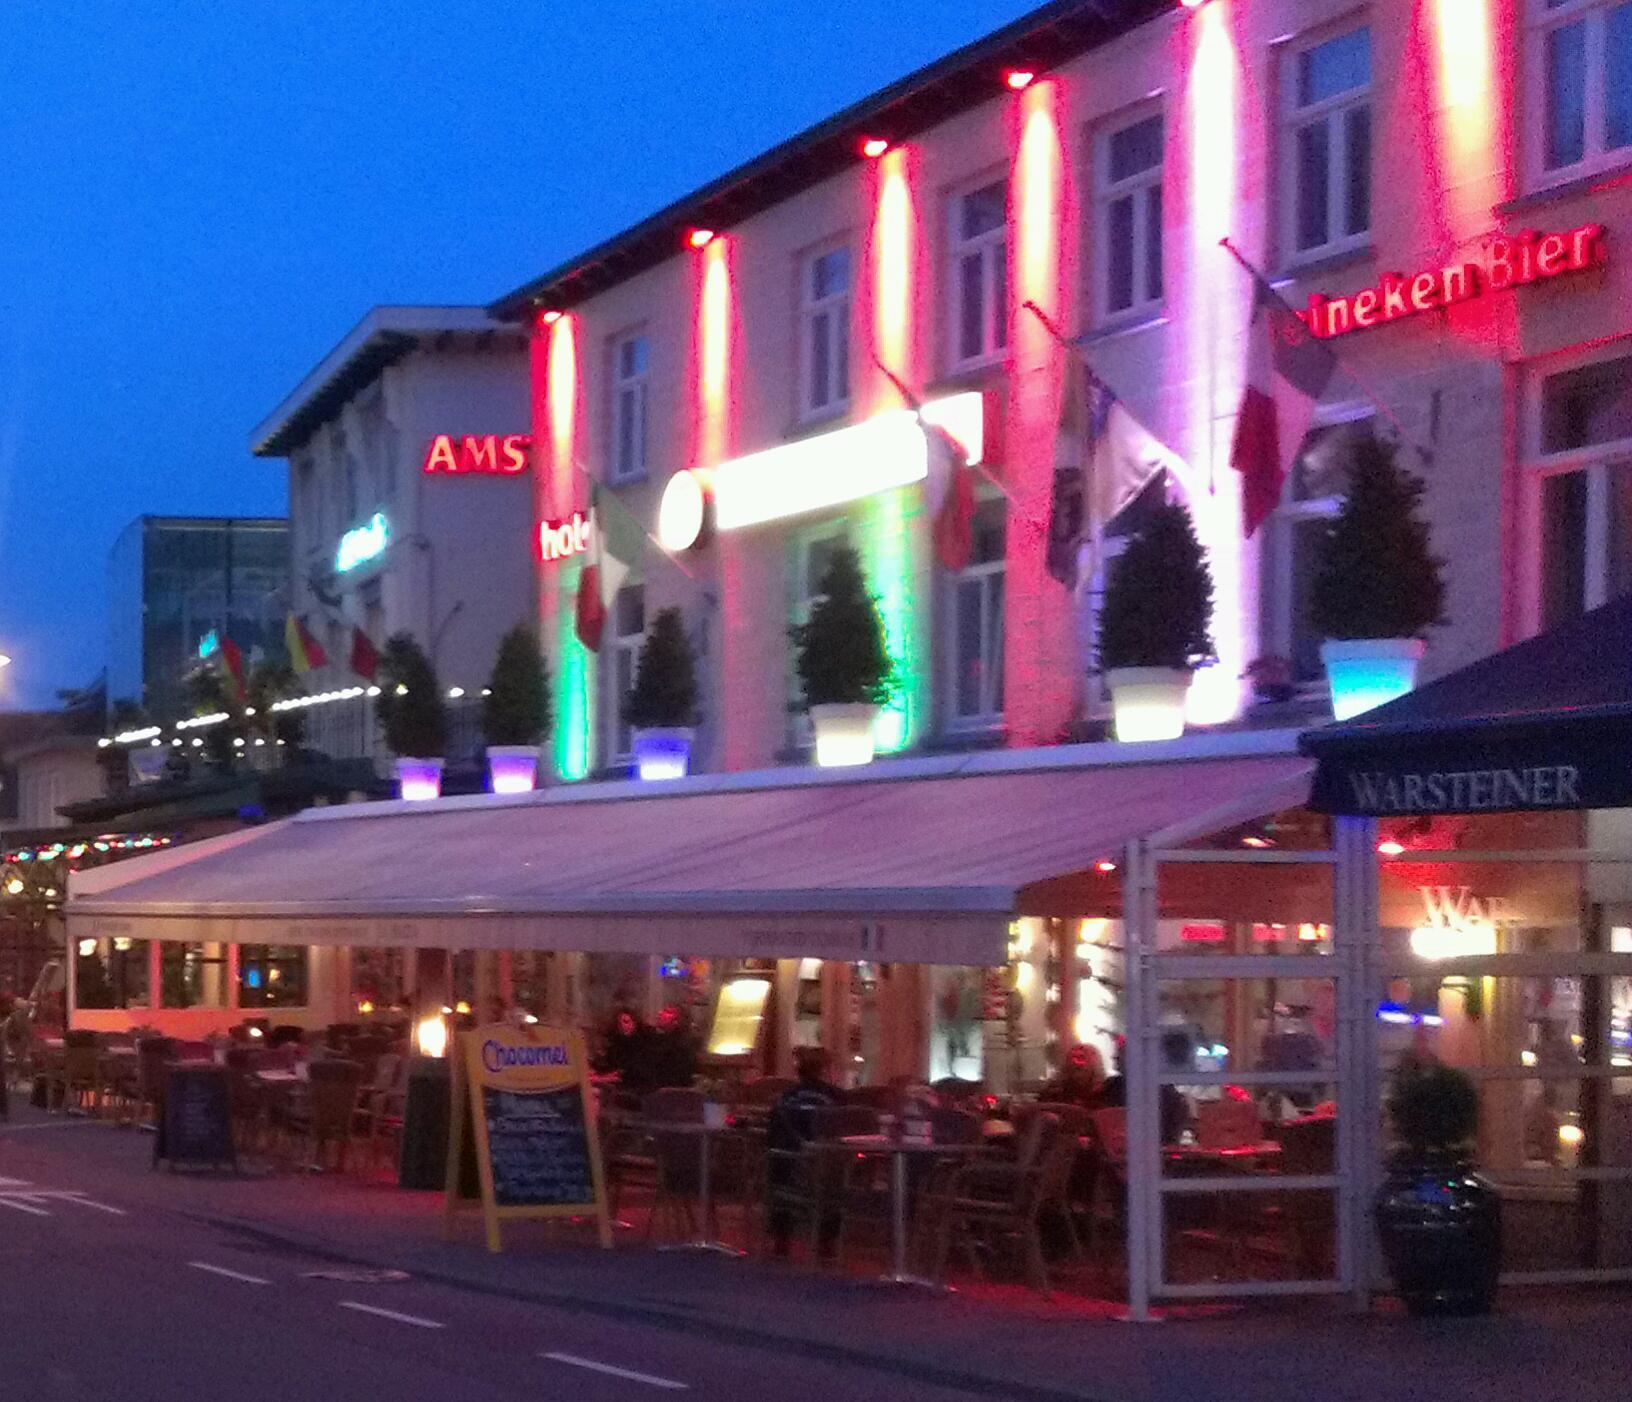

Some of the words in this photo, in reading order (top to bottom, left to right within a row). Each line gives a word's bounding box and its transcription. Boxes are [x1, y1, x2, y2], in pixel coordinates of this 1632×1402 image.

[1294, 264, 1470, 338] ineken
[1484, 224, 1602, 291] Bier
[424, 434, 531, 475] AMS
[1348, 764, 1580, 808] WARSTEINER
